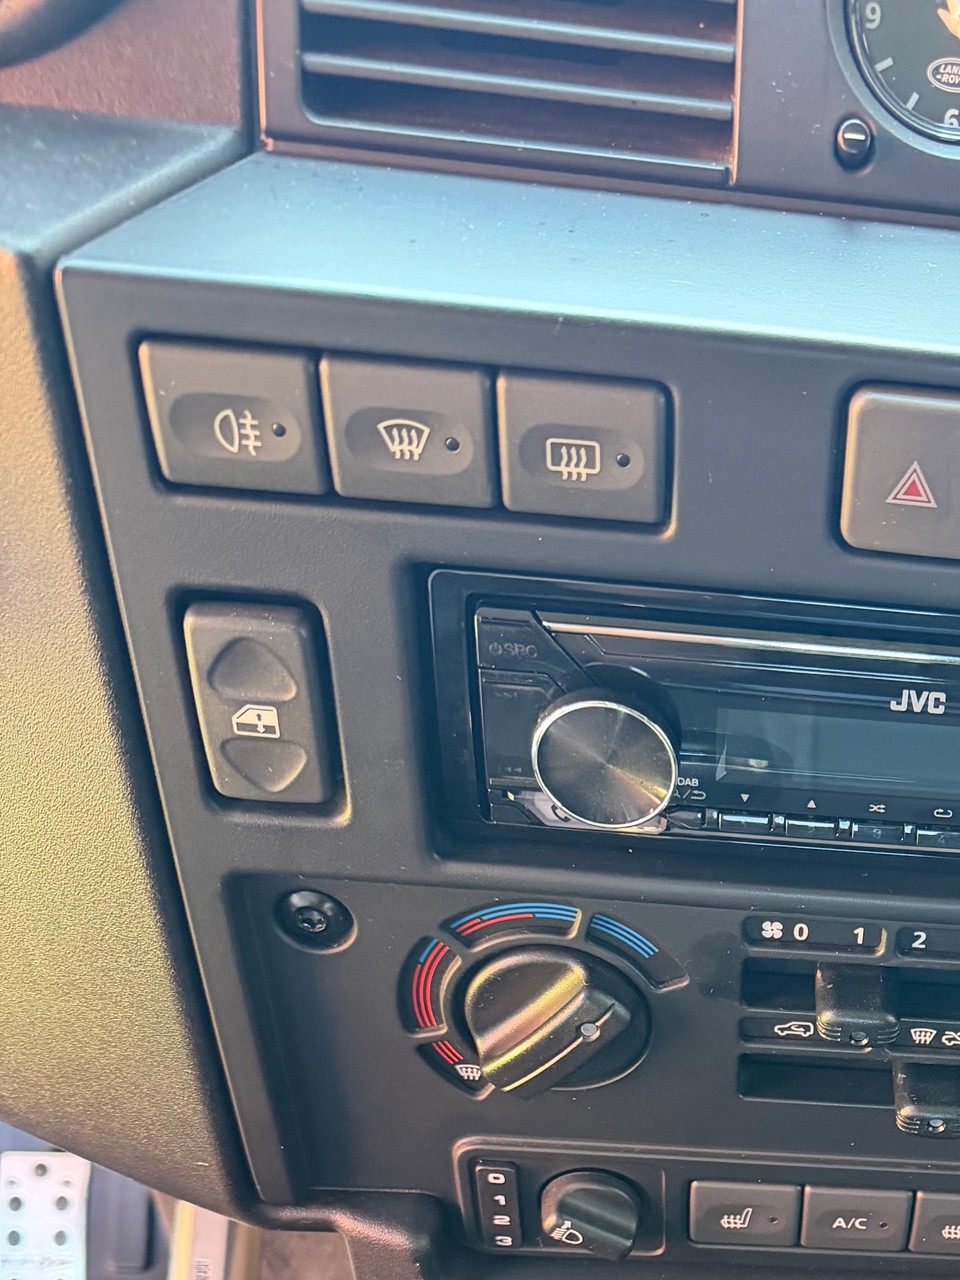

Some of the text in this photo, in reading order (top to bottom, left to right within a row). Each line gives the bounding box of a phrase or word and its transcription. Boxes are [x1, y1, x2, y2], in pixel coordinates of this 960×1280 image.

[864, 2, 882, 30] 9
[944, 108, 959, 128] 6
[889, 689, 947, 716] JVC
[793, 923, 809, 941] 0
[853, 927, 865, 945] 1
[911, 931, 927, 949] 2
[487, 1173, 505, 1184] 0
[494, 1195, 506, 1206] 1
[492, 1215, 511, 1226] 2
[832, 1217, 867, 1230] A/C
[495, 1235, 513, 1247] 3
